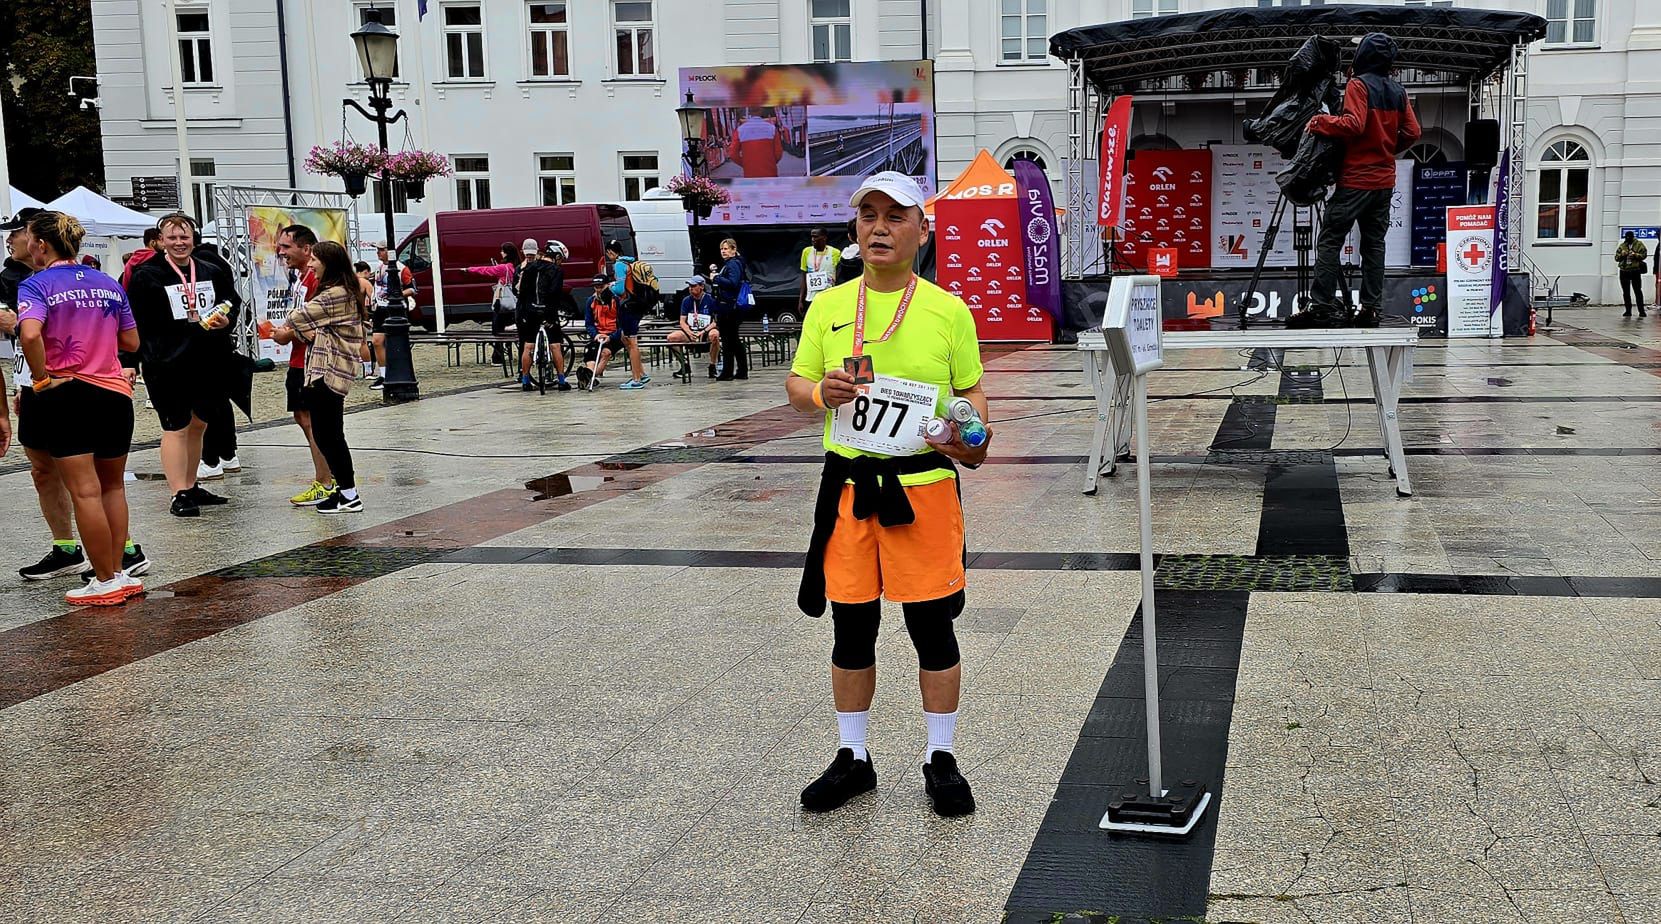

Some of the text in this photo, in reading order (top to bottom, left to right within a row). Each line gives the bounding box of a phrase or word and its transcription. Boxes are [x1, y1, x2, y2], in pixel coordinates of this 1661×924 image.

[978, 239, 1008, 247] ORLEN
[48, 288, 122, 306] CZYSTA FORMA
[181, 292, 207, 310] 96
[76, 299, 110, 308] PŁOCK
[1410, 316, 1436, 324] POKIS
[880, 388, 892, 396] BIEG
[852, 395, 910, 438] 877
